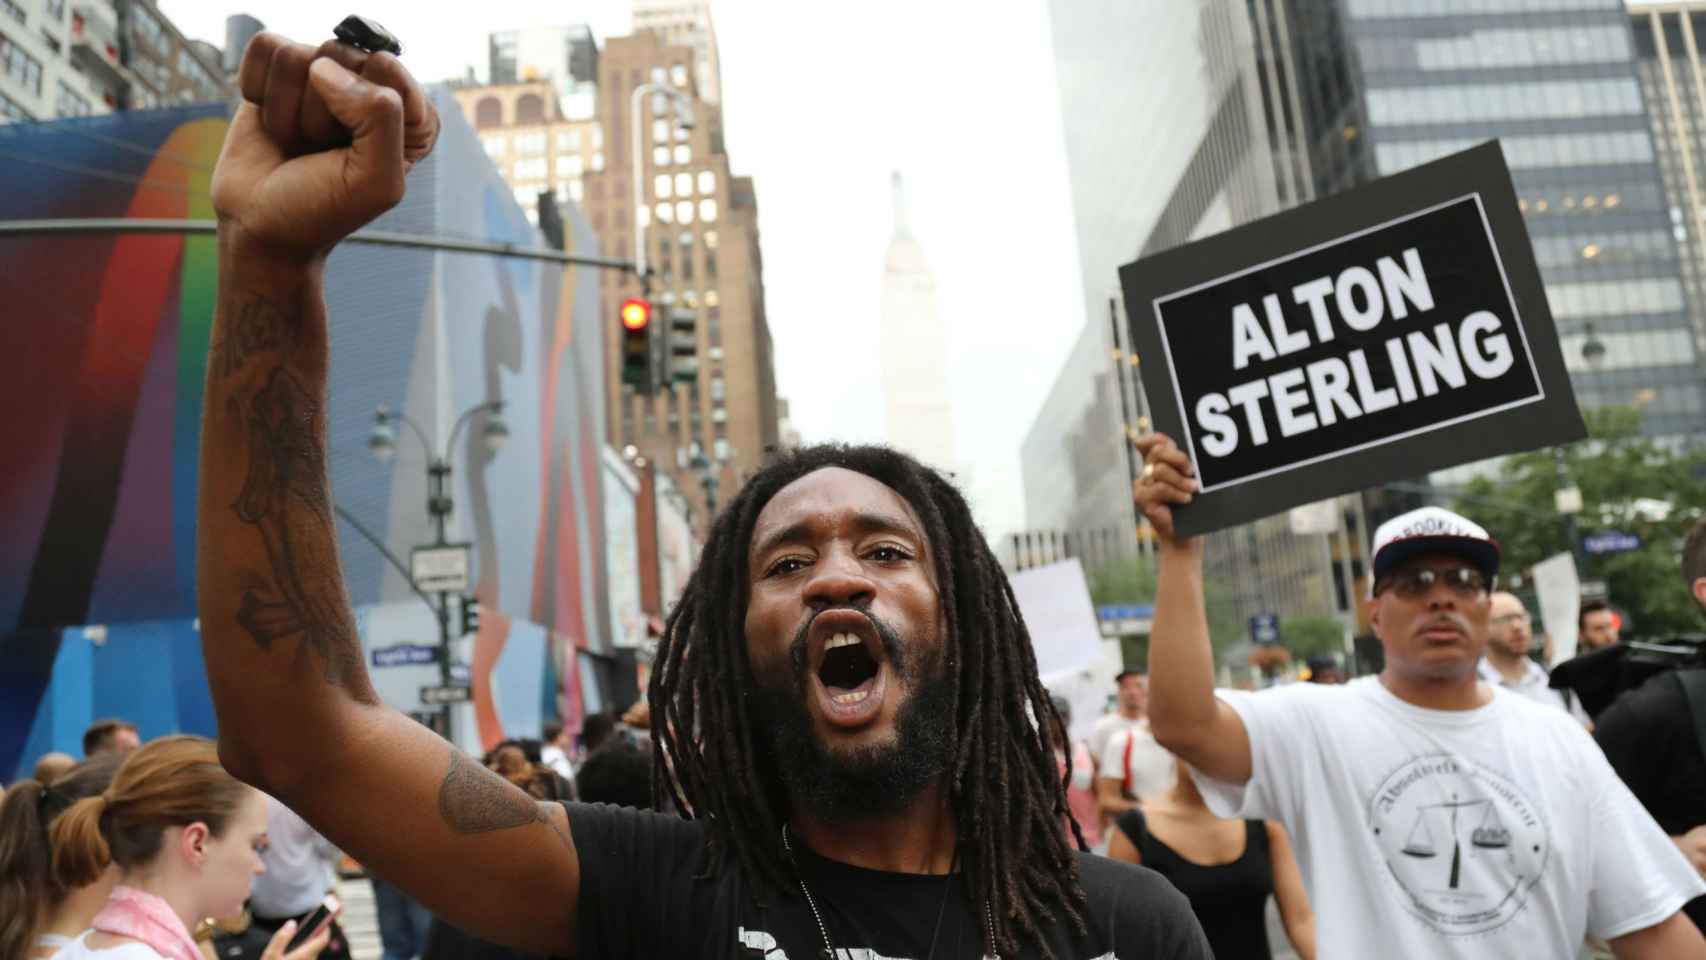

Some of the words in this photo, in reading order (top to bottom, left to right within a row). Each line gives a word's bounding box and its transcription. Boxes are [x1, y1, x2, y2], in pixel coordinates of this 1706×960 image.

[1232, 248, 1435, 370] ALTON
[1195, 310, 1515, 457] STERLING
[1393, 517, 1472, 542] ROOKLY
